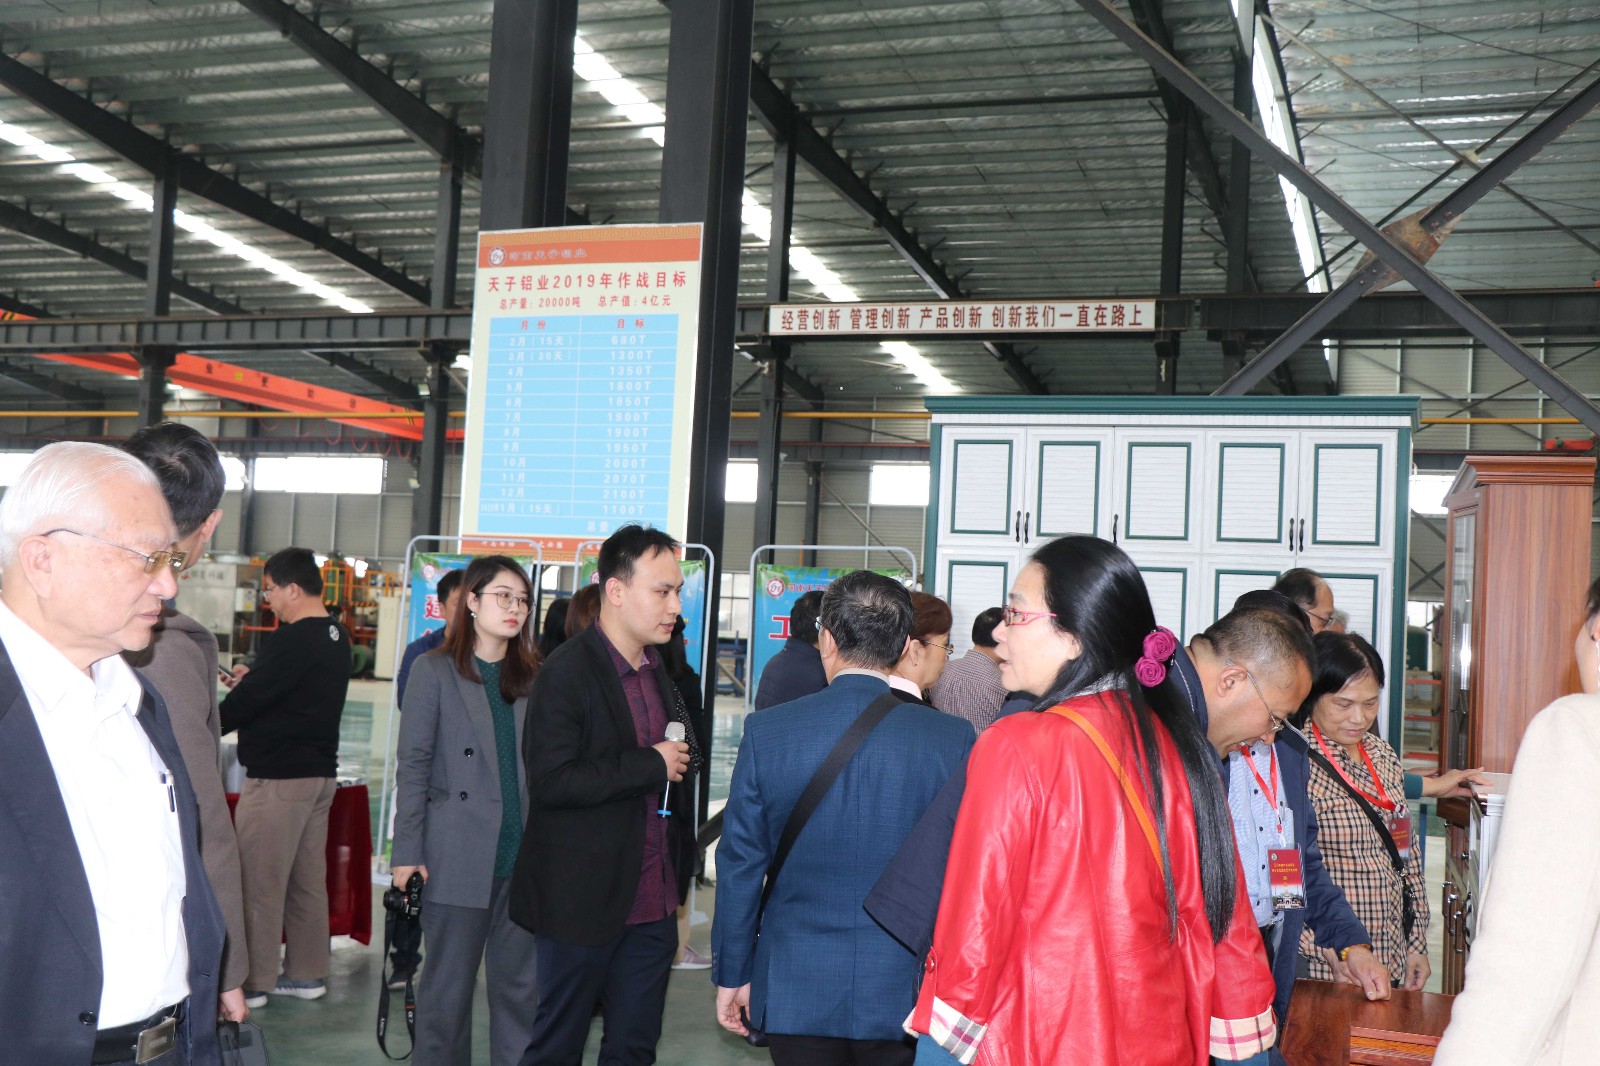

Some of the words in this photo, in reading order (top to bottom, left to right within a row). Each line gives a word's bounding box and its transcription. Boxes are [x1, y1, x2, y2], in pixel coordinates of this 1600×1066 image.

[487, 270, 686, 292] 天子铝业2019年作战目标
[781, 308, 841, 331] 经营创新
[850, 306, 911, 330] 管理创新
[919, 305, 982, 329] 产品创新
[991, 303, 1143, 328] 创新我们一直在路上
